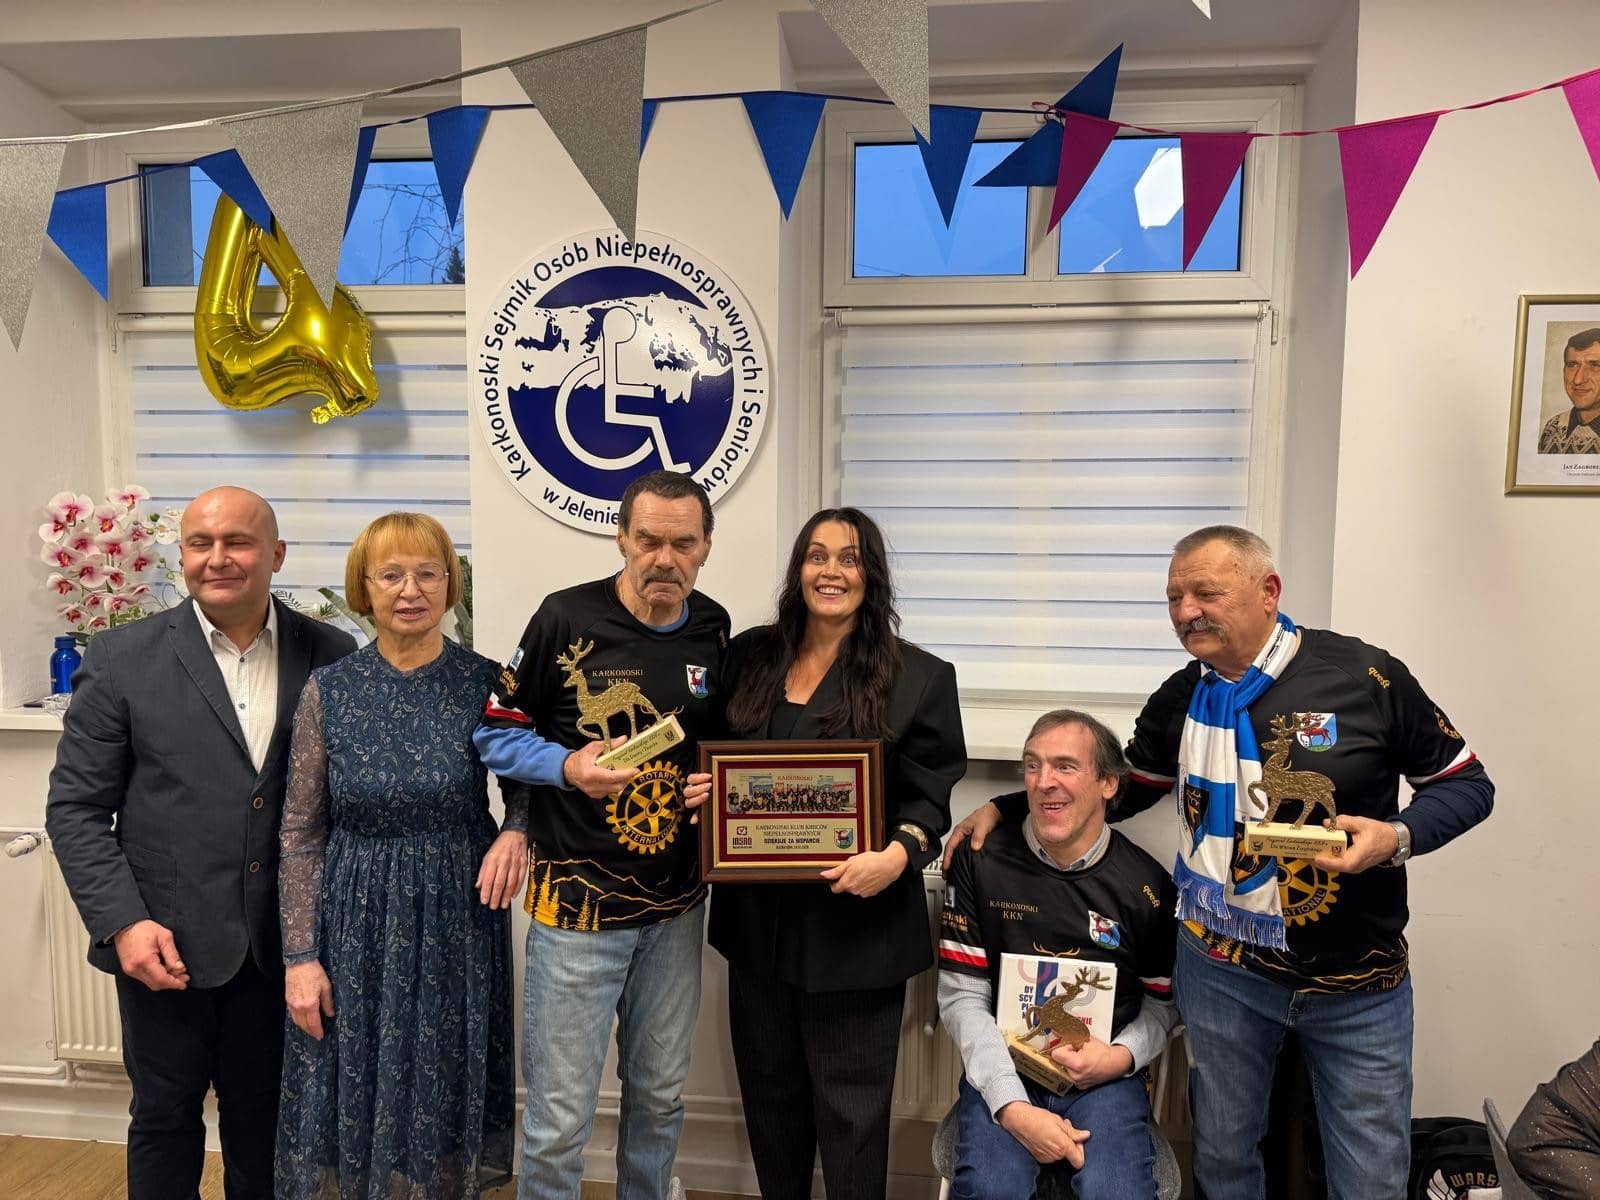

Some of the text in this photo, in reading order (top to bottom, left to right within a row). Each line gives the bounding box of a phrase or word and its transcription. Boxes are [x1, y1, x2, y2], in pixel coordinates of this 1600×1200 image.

[533, 243, 589, 282] Osób
[483, 278, 537, 352] Sejmik
[595, 234, 763, 382] Niepełnosprawnych
[478, 354, 532, 482] Karkonoski
[699, 399, 761, 495] Seniorów
[542, 485, 619, 526] w Jelenie
[592, 668, 643, 677] KARKONOSKI
[638, 771, 674, 783] ROTARY
[989, 900, 1039, 913] KARKONOSKI
[1002, 911, 1023, 921] KKN
[1282, 889, 1326, 917] ATIONAL
[1449, 1172, 1500, 1188] WARS
